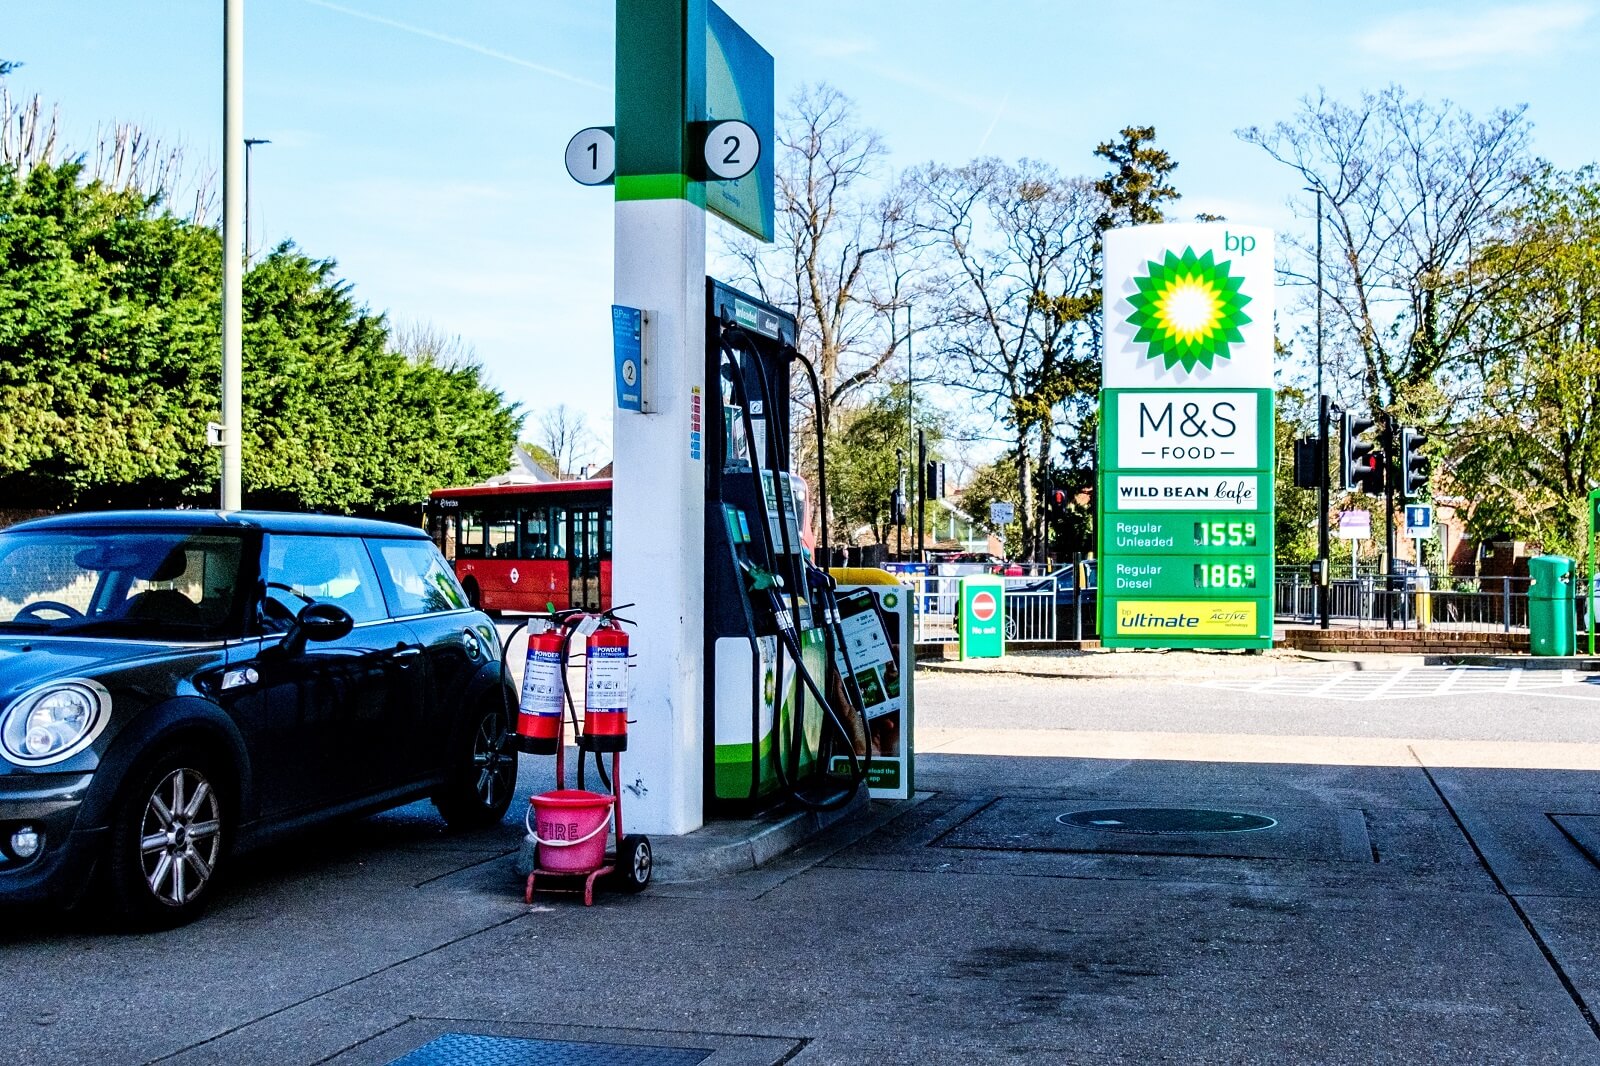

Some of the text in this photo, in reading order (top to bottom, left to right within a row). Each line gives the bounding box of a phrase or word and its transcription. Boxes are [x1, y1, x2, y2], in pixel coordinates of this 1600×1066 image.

[587, 142, 598, 170] 1
[722, 135, 741, 164] 2
[1225, 230, 1256, 256] bp
[627, 365, 634, 380] 2
[1139, 401, 1237, 439] M&S
[1161, 446, 1216, 460] FOOD
[1120, 486, 1159, 498] WILD
[1163, 486, 1210, 498] BEAN
[1116, 522, 1162, 535] Regular
[1116, 536, 1174, 547] Unleaded
[1116, 564, 1162, 576] Regular
[1116, 578, 1153, 589] Diesel
[1121, 613, 1200, 628] ultimate
[1210, 611, 1248, 621] ACTIVE
[539, 822, 580, 841] FIRE
